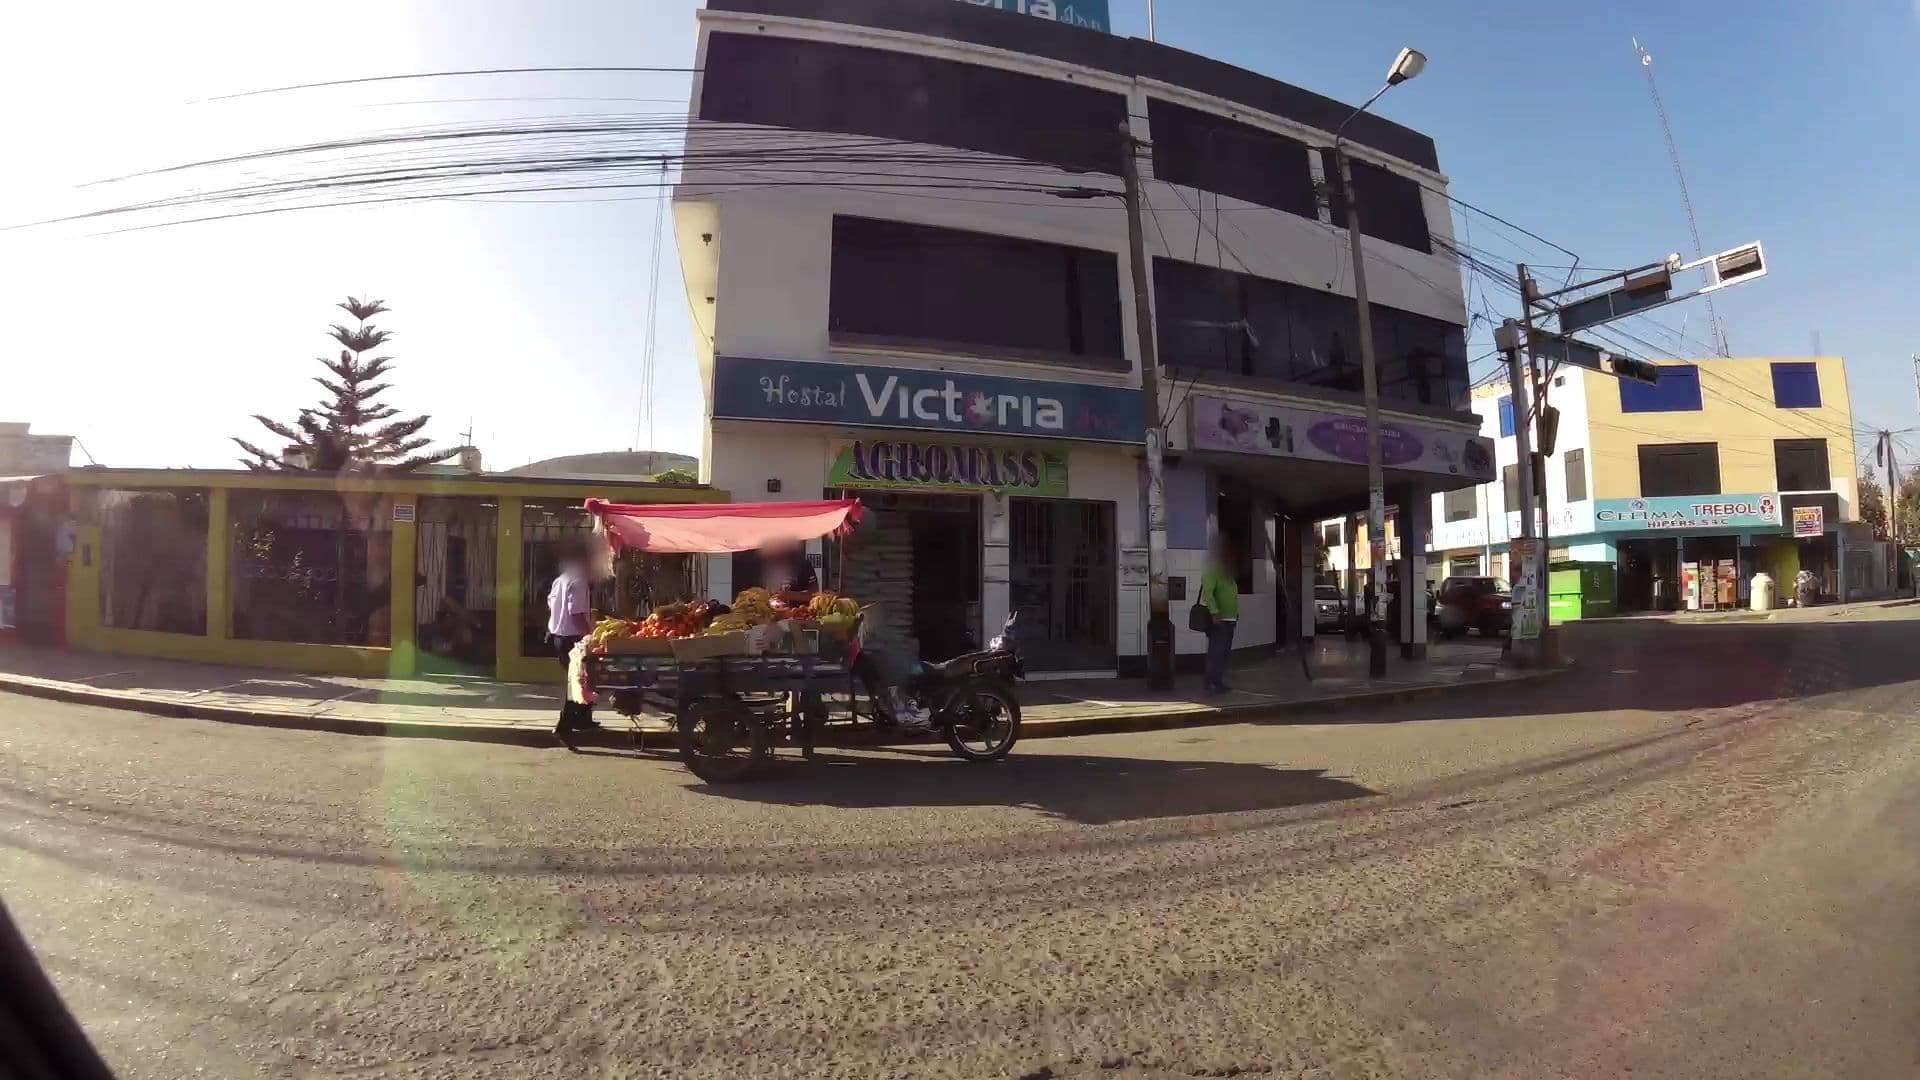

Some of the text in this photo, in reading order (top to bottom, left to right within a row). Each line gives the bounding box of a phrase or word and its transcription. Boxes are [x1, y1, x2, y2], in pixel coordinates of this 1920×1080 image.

[760, 375, 845, 408] Hostal
[855, 373, 1064, 430] Victoria
[1692, 503, 1757, 516] TREBOL
